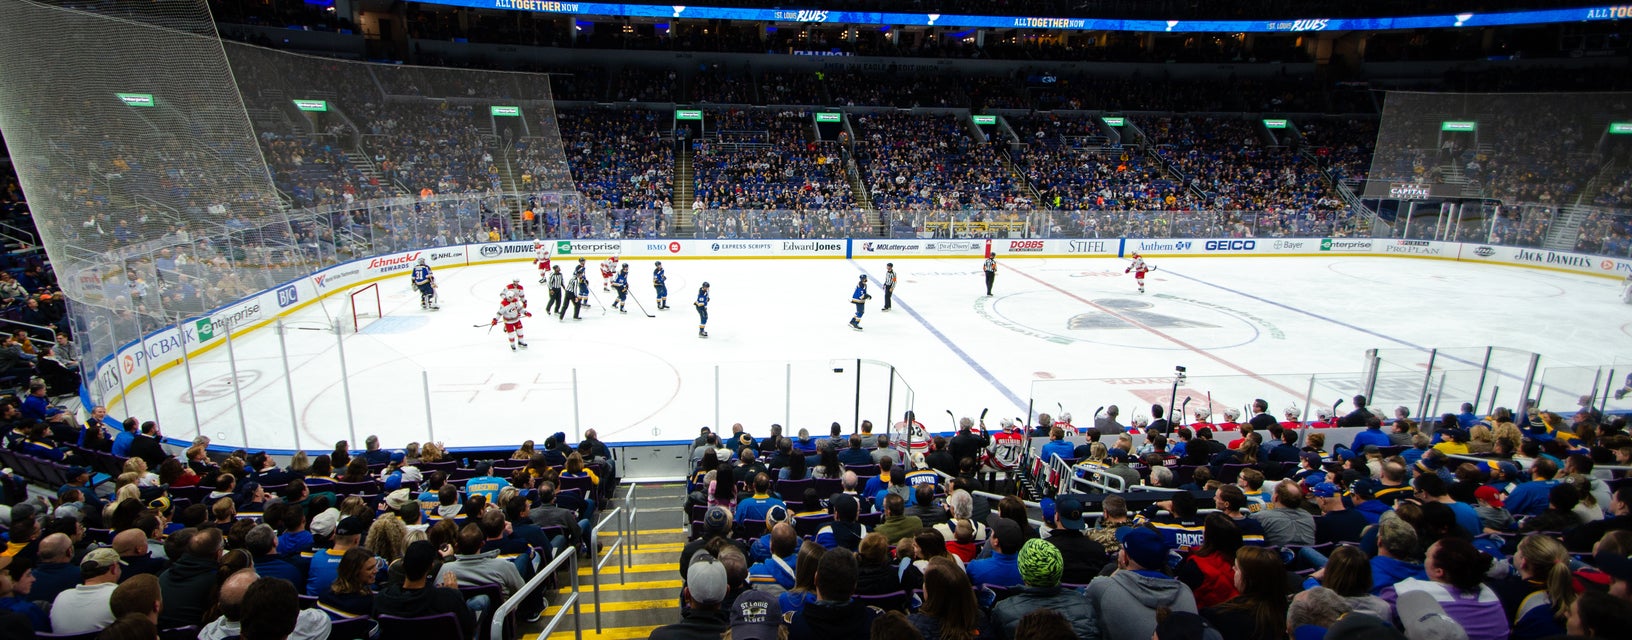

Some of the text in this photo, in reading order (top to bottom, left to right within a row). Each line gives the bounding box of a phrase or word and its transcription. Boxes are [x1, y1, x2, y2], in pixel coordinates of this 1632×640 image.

[504, 244, 535, 253] MIDWE
[560, 241, 620, 253] enterprise
[1010, 240, 1044, 249] DOBBS
[1068, 240, 1107, 253] STIFEL
[1138, 241, 1173, 251] Anthem
[1205, 240, 1255, 251] GEICO
[1283, 241, 1303, 250] Bayer
[1321, 240, 1371, 250] enterprise
[367, 252, 421, 269] Schnucks
[1514, 249, 1544, 262] JACK
[1546, 251, 1592, 268] DANIEL'S
[380, 263, 410, 273] REWARDS
[415, 271, 423, 280] 31
[278, 287, 296, 302] BJC
